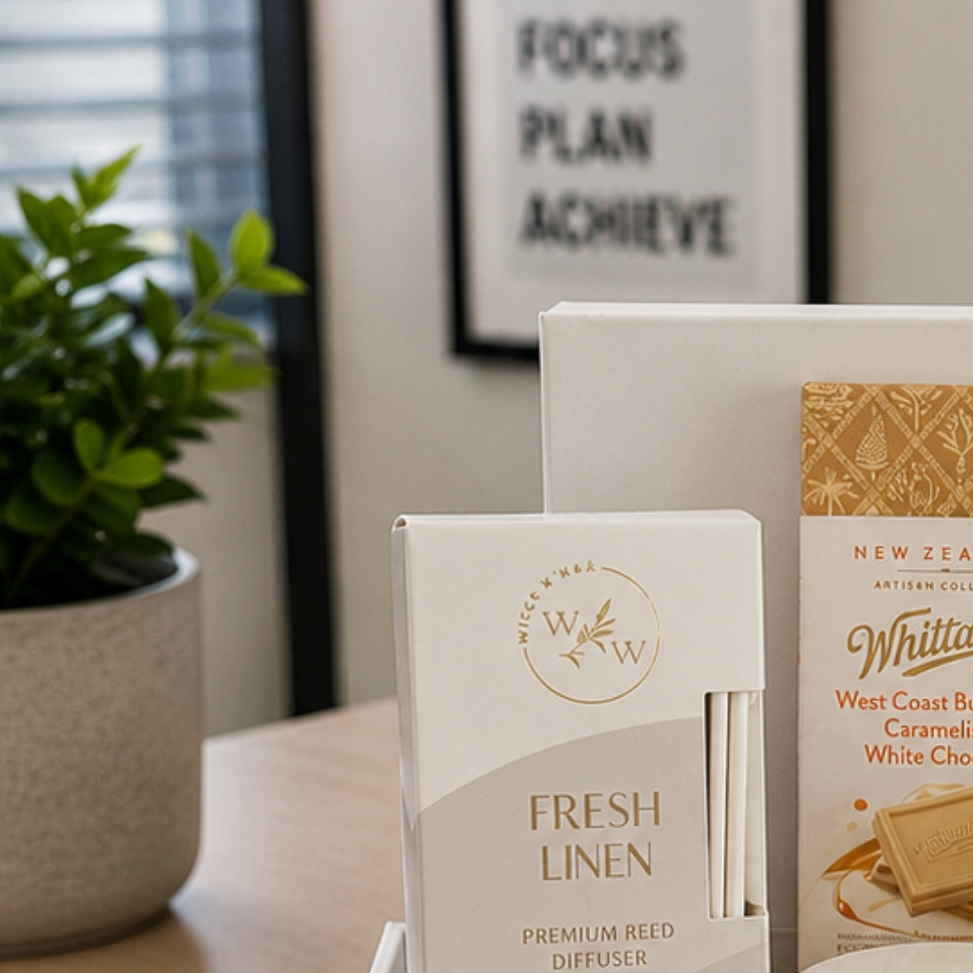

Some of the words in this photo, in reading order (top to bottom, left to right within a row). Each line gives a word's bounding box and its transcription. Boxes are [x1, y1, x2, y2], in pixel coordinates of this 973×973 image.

[517, 16, 687, 80] FOCUS
[519, 104, 654, 168] PLAN
[519, 189, 736, 257] ACHIEVE
[853, 546, 909, 560] NEW
[835, 690, 887, 711] West
[892, 691, 949, 711] Coast
[864, 744, 925, 765] White
[530, 791, 661, 831] FRESH
[541, 842, 652, 882] LINEN
[522, 925, 618, 945] PREMIUM
[625, 922, 675, 941] REED
[552, 949, 648, 970] DIFFUSER
